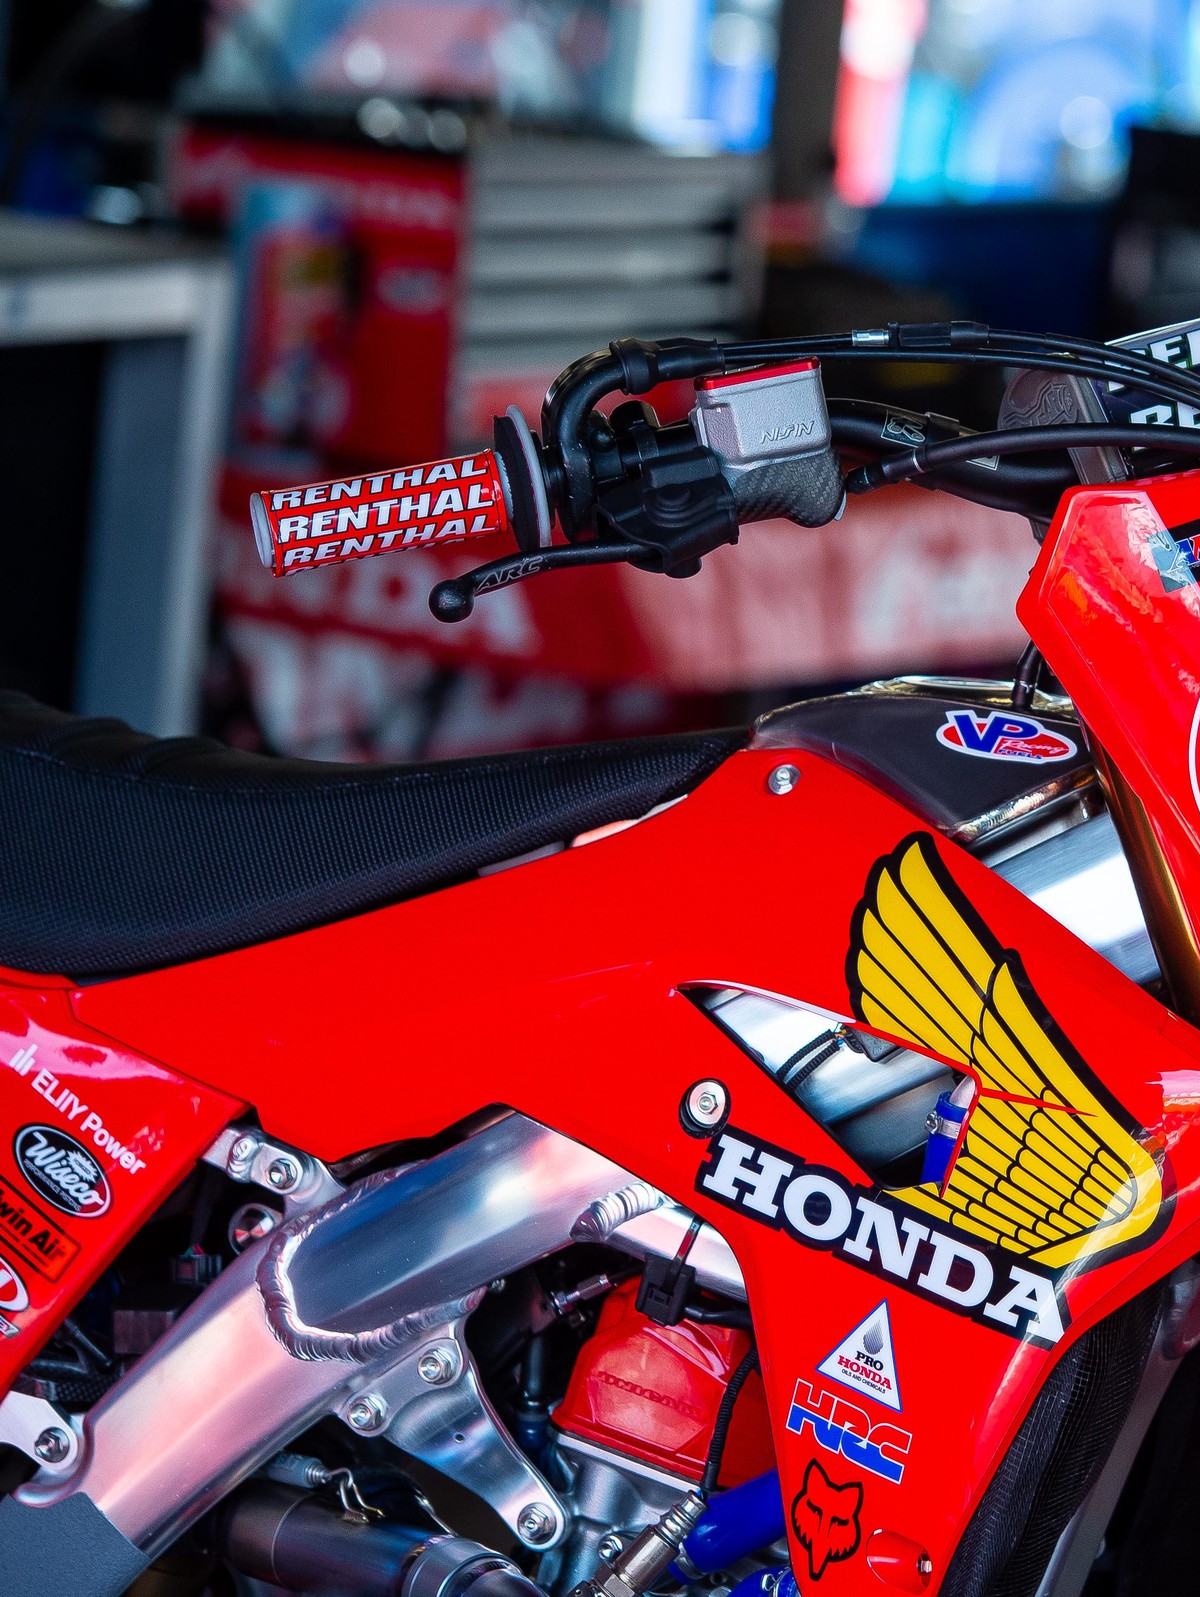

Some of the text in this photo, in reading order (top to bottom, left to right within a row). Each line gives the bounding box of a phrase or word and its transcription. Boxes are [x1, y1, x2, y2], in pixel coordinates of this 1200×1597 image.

[271, 458, 488, 511] RENTHAL
[279, 483, 494, 544] RENTHAL
[283, 514, 497, 567] RENTHAL
[475, 555, 544, 592] ARC
[953, 714, 1039, 753] VP
[999, 748, 1043, 760] FUELS
[80, 1111, 147, 1175] Power
[25, 1131, 104, 1206] Wiseco
[28, 1229, 66, 1260] Air
[702, 1133, 1065, 1343] HONDA
[837, 1354, 892, 1390] HONDA
[841, 1369, 886, 1394] OILS AND CHEMICALS
[854, 1350, 884, 1371] PRO
[786, 1378, 913, 1485] HRC
